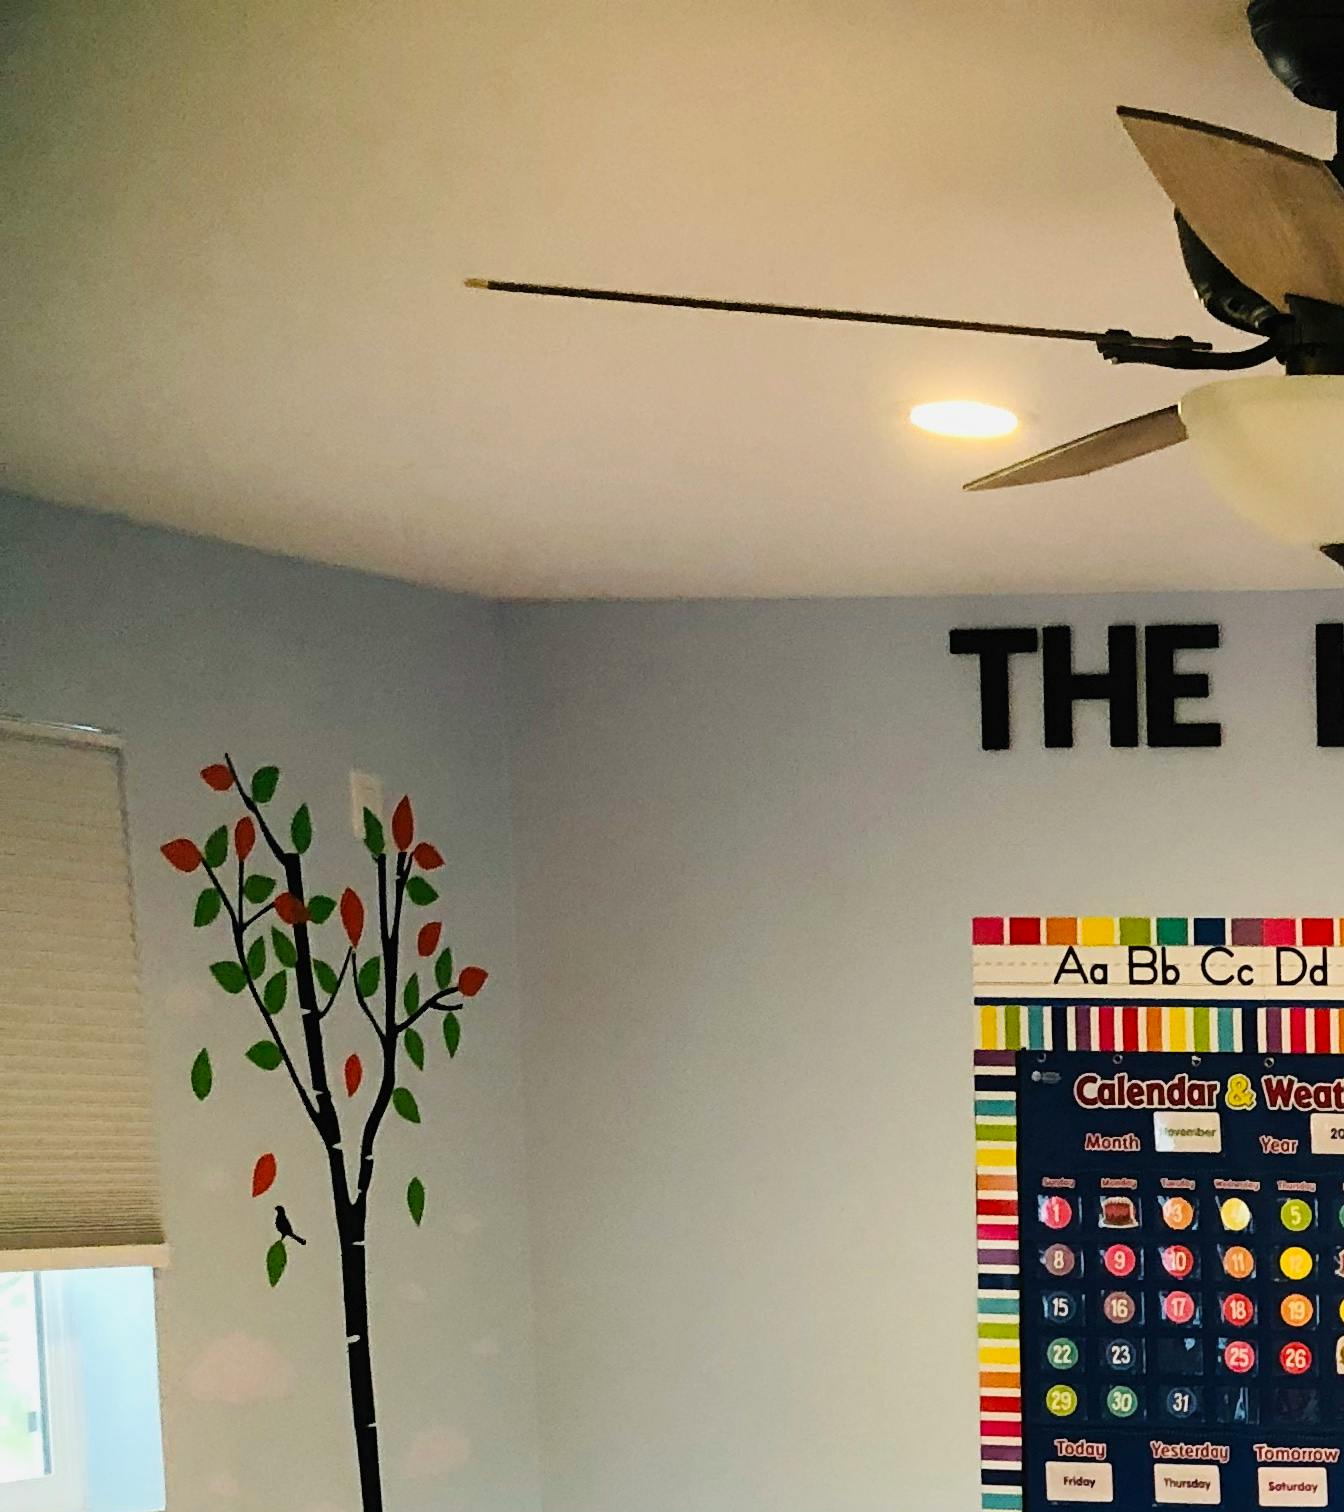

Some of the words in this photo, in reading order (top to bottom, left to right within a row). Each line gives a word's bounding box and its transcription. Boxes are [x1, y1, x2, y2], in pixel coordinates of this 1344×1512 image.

[950, 624, 1221, 750] THE
[1053, 946, 1109, 985] Aa
[1128, 947, 1181, 986] Bb
[1200, 948, 1254, 987] Cc
[1275, 947, 1328, 987] Dd
[1075, 1073, 1219, 1108] Calendar
[1226, 1074, 1256, 1109] &
[1086, 1133, 1140, 1151] Month
[1260, 1135, 1298, 1154] Year
[1052, 1203, 1060, 1223] 1
[1174, 1205, 1184, 1222] 3
[1290, 1205, 1301, 1224] 5
[1053, 1250, 1065, 1270] 8
[1113, 1249, 1126, 1270] 9
[1170, 1251, 1187, 1271] 10
[1231, 1253, 1245, 1272] 11
[1052, 1298, 1069, 1317] 15
[1111, 1299, 1128, 1318] 16
[1170, 1298, 1187, 1316] 17
[1229, 1300, 1247, 1320] 18
[1288, 1301, 1306, 1320] 19
[1053, 1345, 1072, 1364] 22
[1111, 1345, 1131, 1365] 23
[1230, 1347, 1250, 1367] 25
[1285, 1349, 1306, 1369] 26
[1051, 1391, 1072, 1411] 29
[1111, 1391, 1132, 1411] 30
[1172, 1392, 1189, 1412] 31
[1056, 1438, 1106, 1460] Today
[1151, 1441, 1229, 1463] Yesterday
[1254, 1443, 1339, 1462] Tomorrow
[1063, 1475, 1096, 1488] Friday
[1163, 1477, 1212, 1491] Thursday
[1268, 1481, 1319, 1494] Saturday
